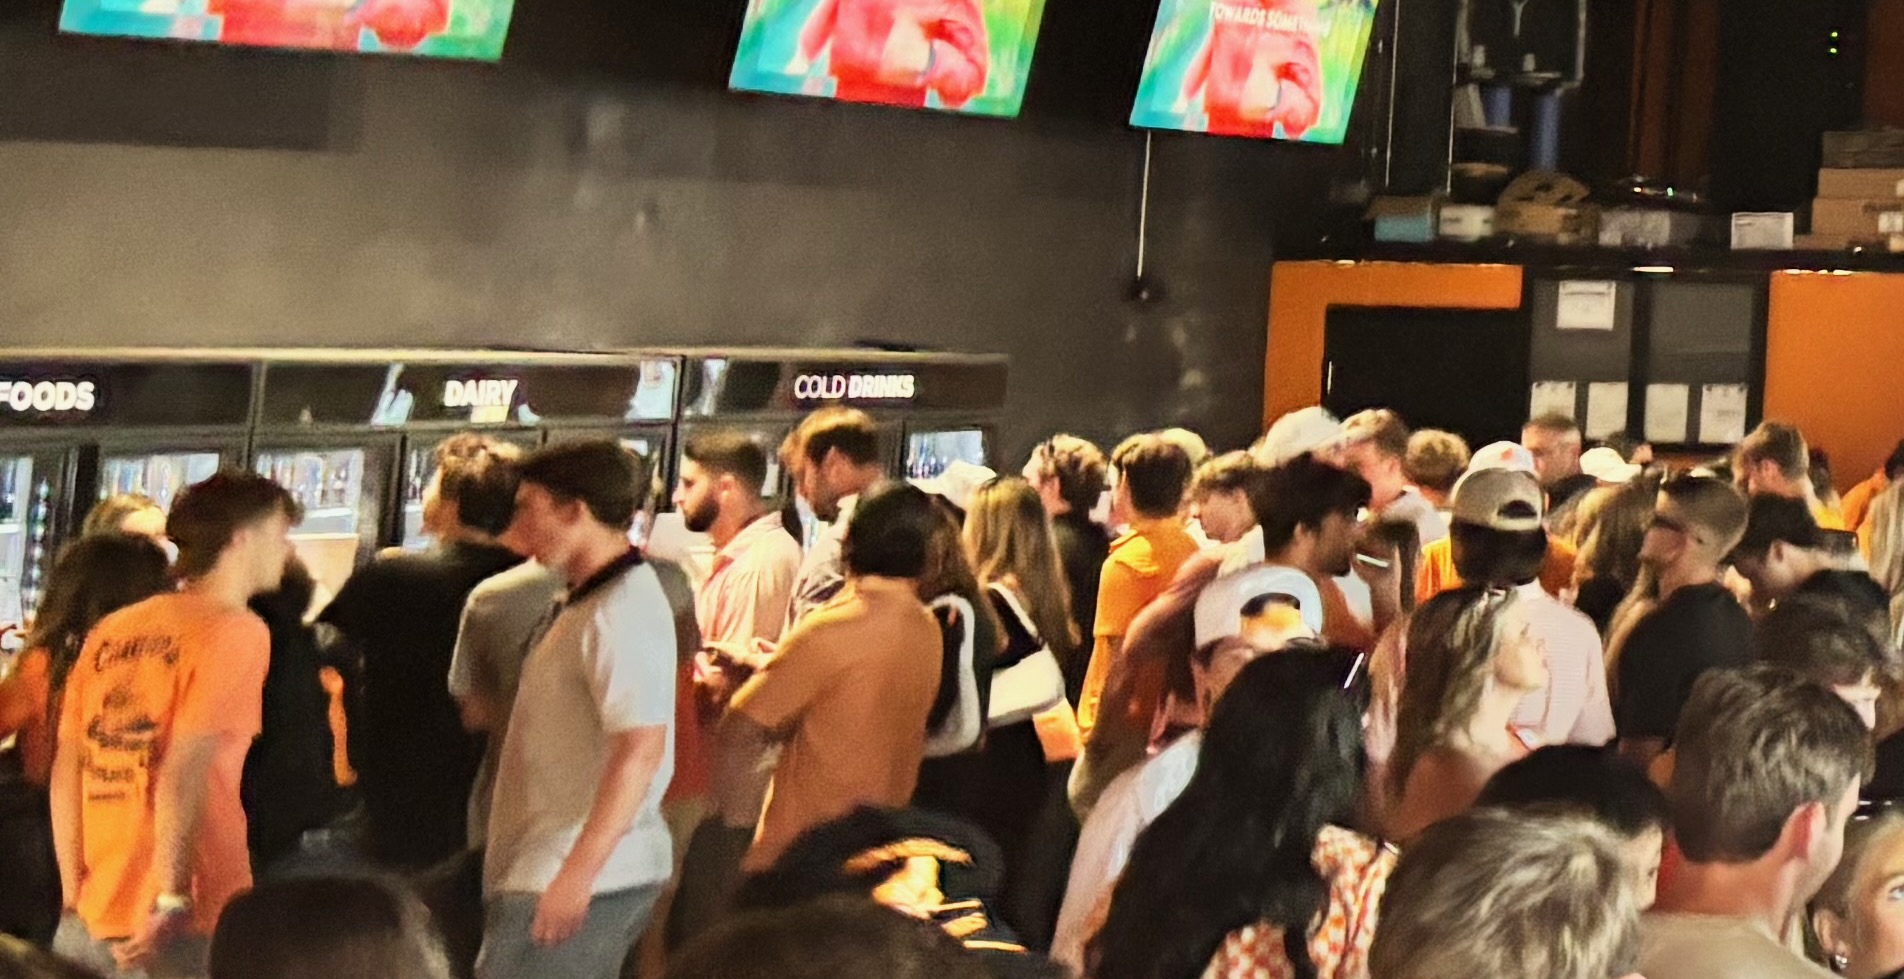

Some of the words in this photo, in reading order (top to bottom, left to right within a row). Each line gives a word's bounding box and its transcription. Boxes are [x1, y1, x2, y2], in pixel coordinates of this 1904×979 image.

[443, 379, 518, 407] DAIRY
[794, 374, 847, 399] COLD
[847, 374, 915, 399] DRINKS
